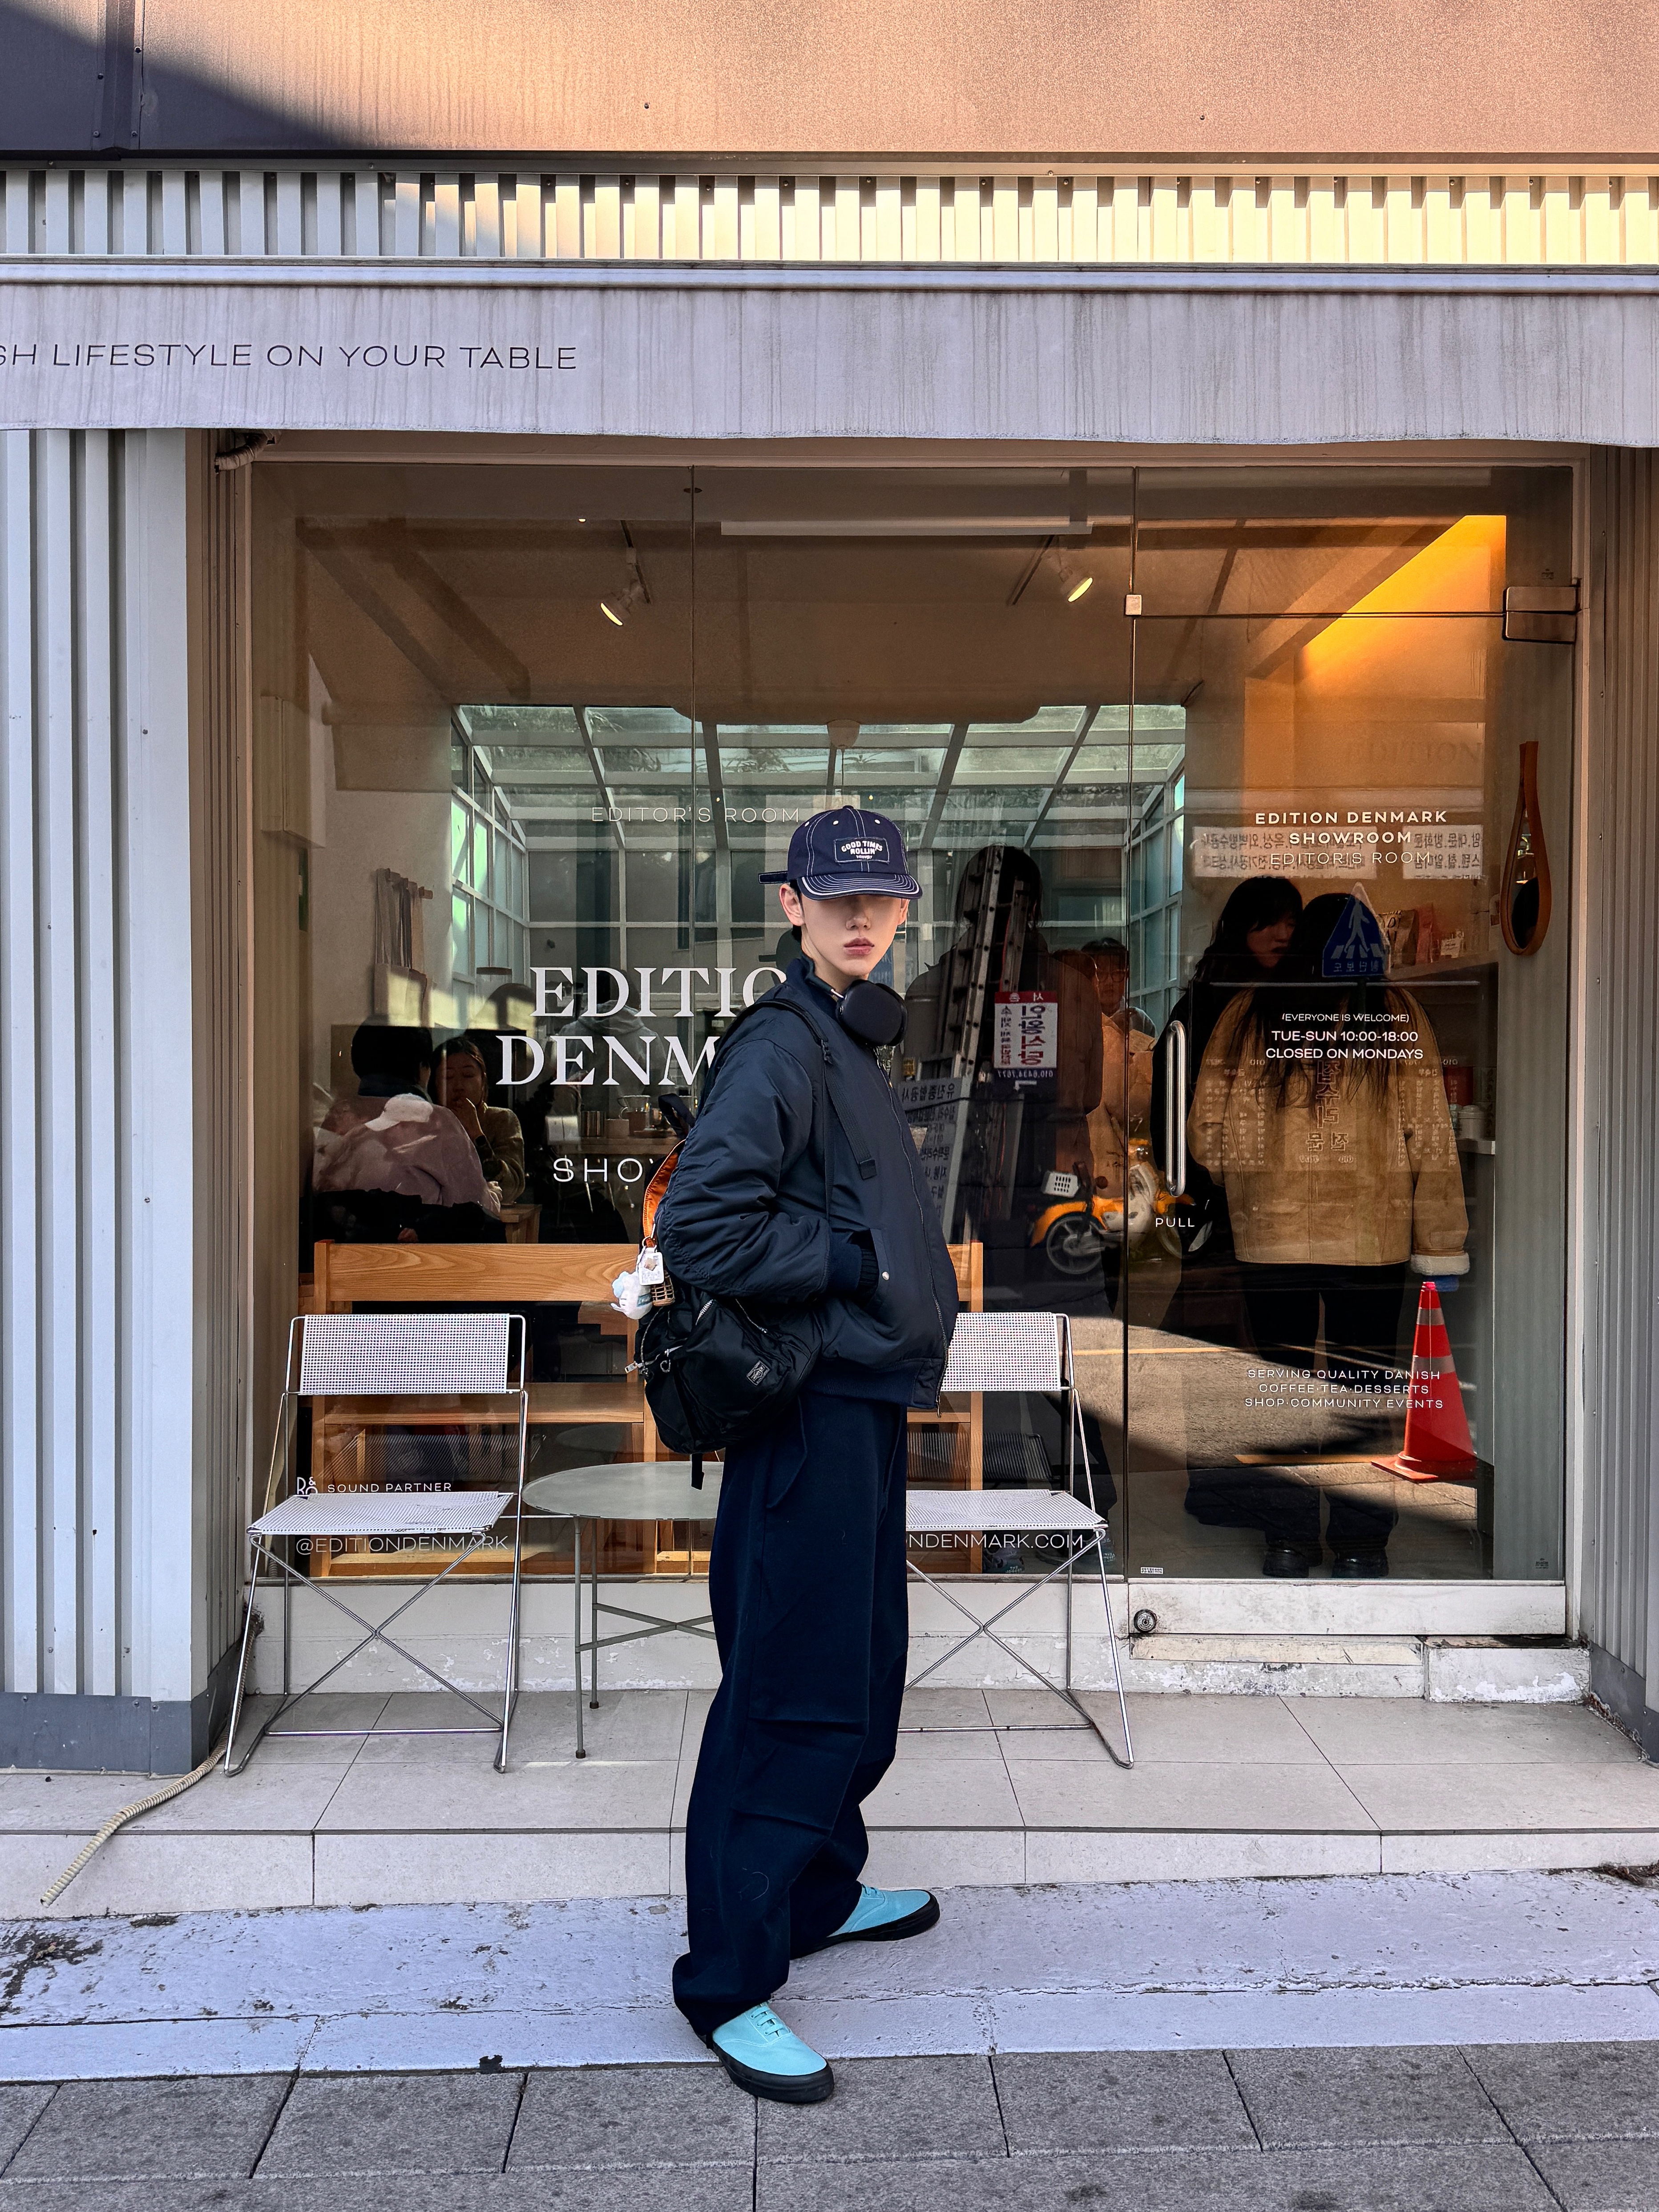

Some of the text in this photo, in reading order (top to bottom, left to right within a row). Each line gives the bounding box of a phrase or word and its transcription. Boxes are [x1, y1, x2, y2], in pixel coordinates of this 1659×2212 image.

[53, 344, 252, 367] LIFESTYLE
[267, 345, 323, 367] ON
[339, 345, 445, 368] YOUR
[459, 347, 576, 369] TABLE
[725, 808, 799, 823] ROOM
[1255, 811, 1447, 825] EDITION DENMARK
[1289, 831, 1411, 845] SHOWROOM
[841, 841, 861, 852] GOOD
[1372, 851, 1430, 864] ROOM
[1281, 1013, 1340, 1022] (EVERYONE
[1353, 1013, 1409, 1023] WELCOME)
[1271, 1031, 1418, 1042] TUE-SUN 10:00-18:00
[1266, 1048, 1424, 1059] CLOSED ON MONDAYS
[553, 1158, 653, 1183] SHO
[1155, 1217, 1195, 1227] PULL
[1247, 1369, 1440, 1379] SERVING QUALITY DANISH
[1386, 1399, 1443, 1409] EVENTS
[327, 1484, 379, 1493] SOUND
[386, 1482, 452, 1492] PARTNER
[296, 1536, 509, 1555] @EDITIONDENMARK
[906, 1533, 1083, 1549] NDENMARK.COM
